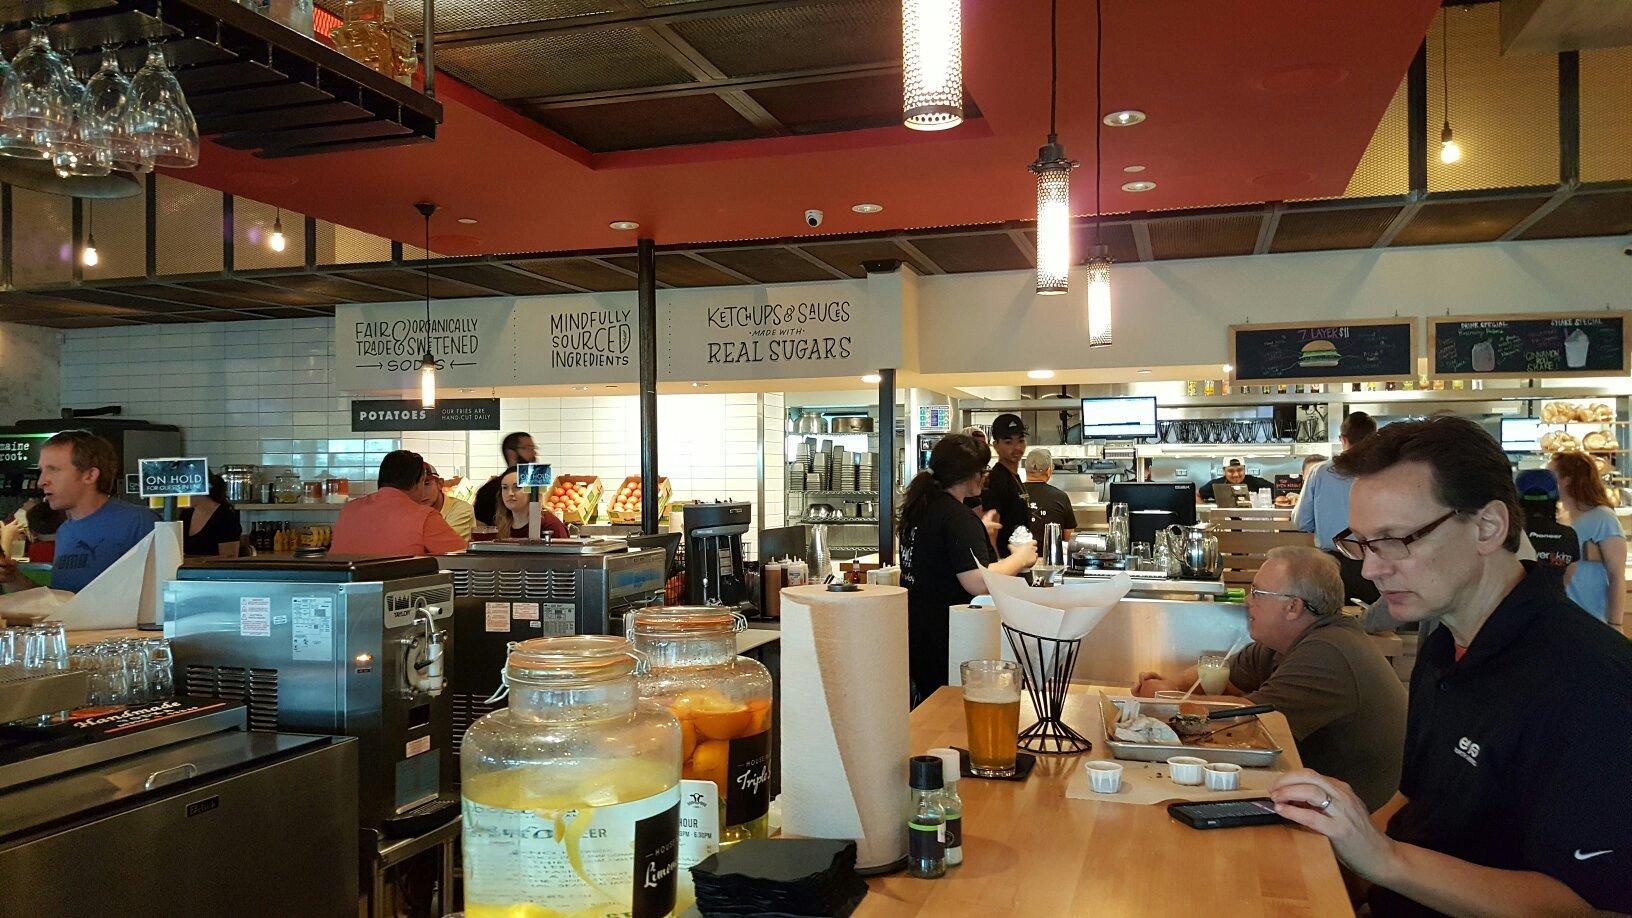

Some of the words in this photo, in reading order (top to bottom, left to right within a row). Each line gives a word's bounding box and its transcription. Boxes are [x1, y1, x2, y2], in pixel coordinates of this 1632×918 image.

[551, 310, 631, 335] MINDFULLY
[707, 304, 783, 329] KETCHUPS
[783, 304, 795, 322] &
[797, 301, 851, 323] SAUCES
[355, 321, 391, 339] FAIR
[412, 318, 478, 334] ORGANICALLY
[752, 329, 776, 337] MADE
[779, 328, 802, 336] WITH
[1299, 329, 1307, 339] 7
[1310, 328, 1340, 339] LAYER
[552, 323, 631, 354] SOURCED
[356, 340, 392, 356] TRADE
[707, 341, 764, 363] REAL
[769, 336, 852, 361] SUGARS
[387, 359, 446, 371] SODS
[552, 350, 629, 368] INGREDIENTS
[360, 410, 427, 421] POTATOES
[146, 476, 166, 485] ON
[170, 474, 202, 484] HOLD
[73, 701, 182, 729] Handmade
